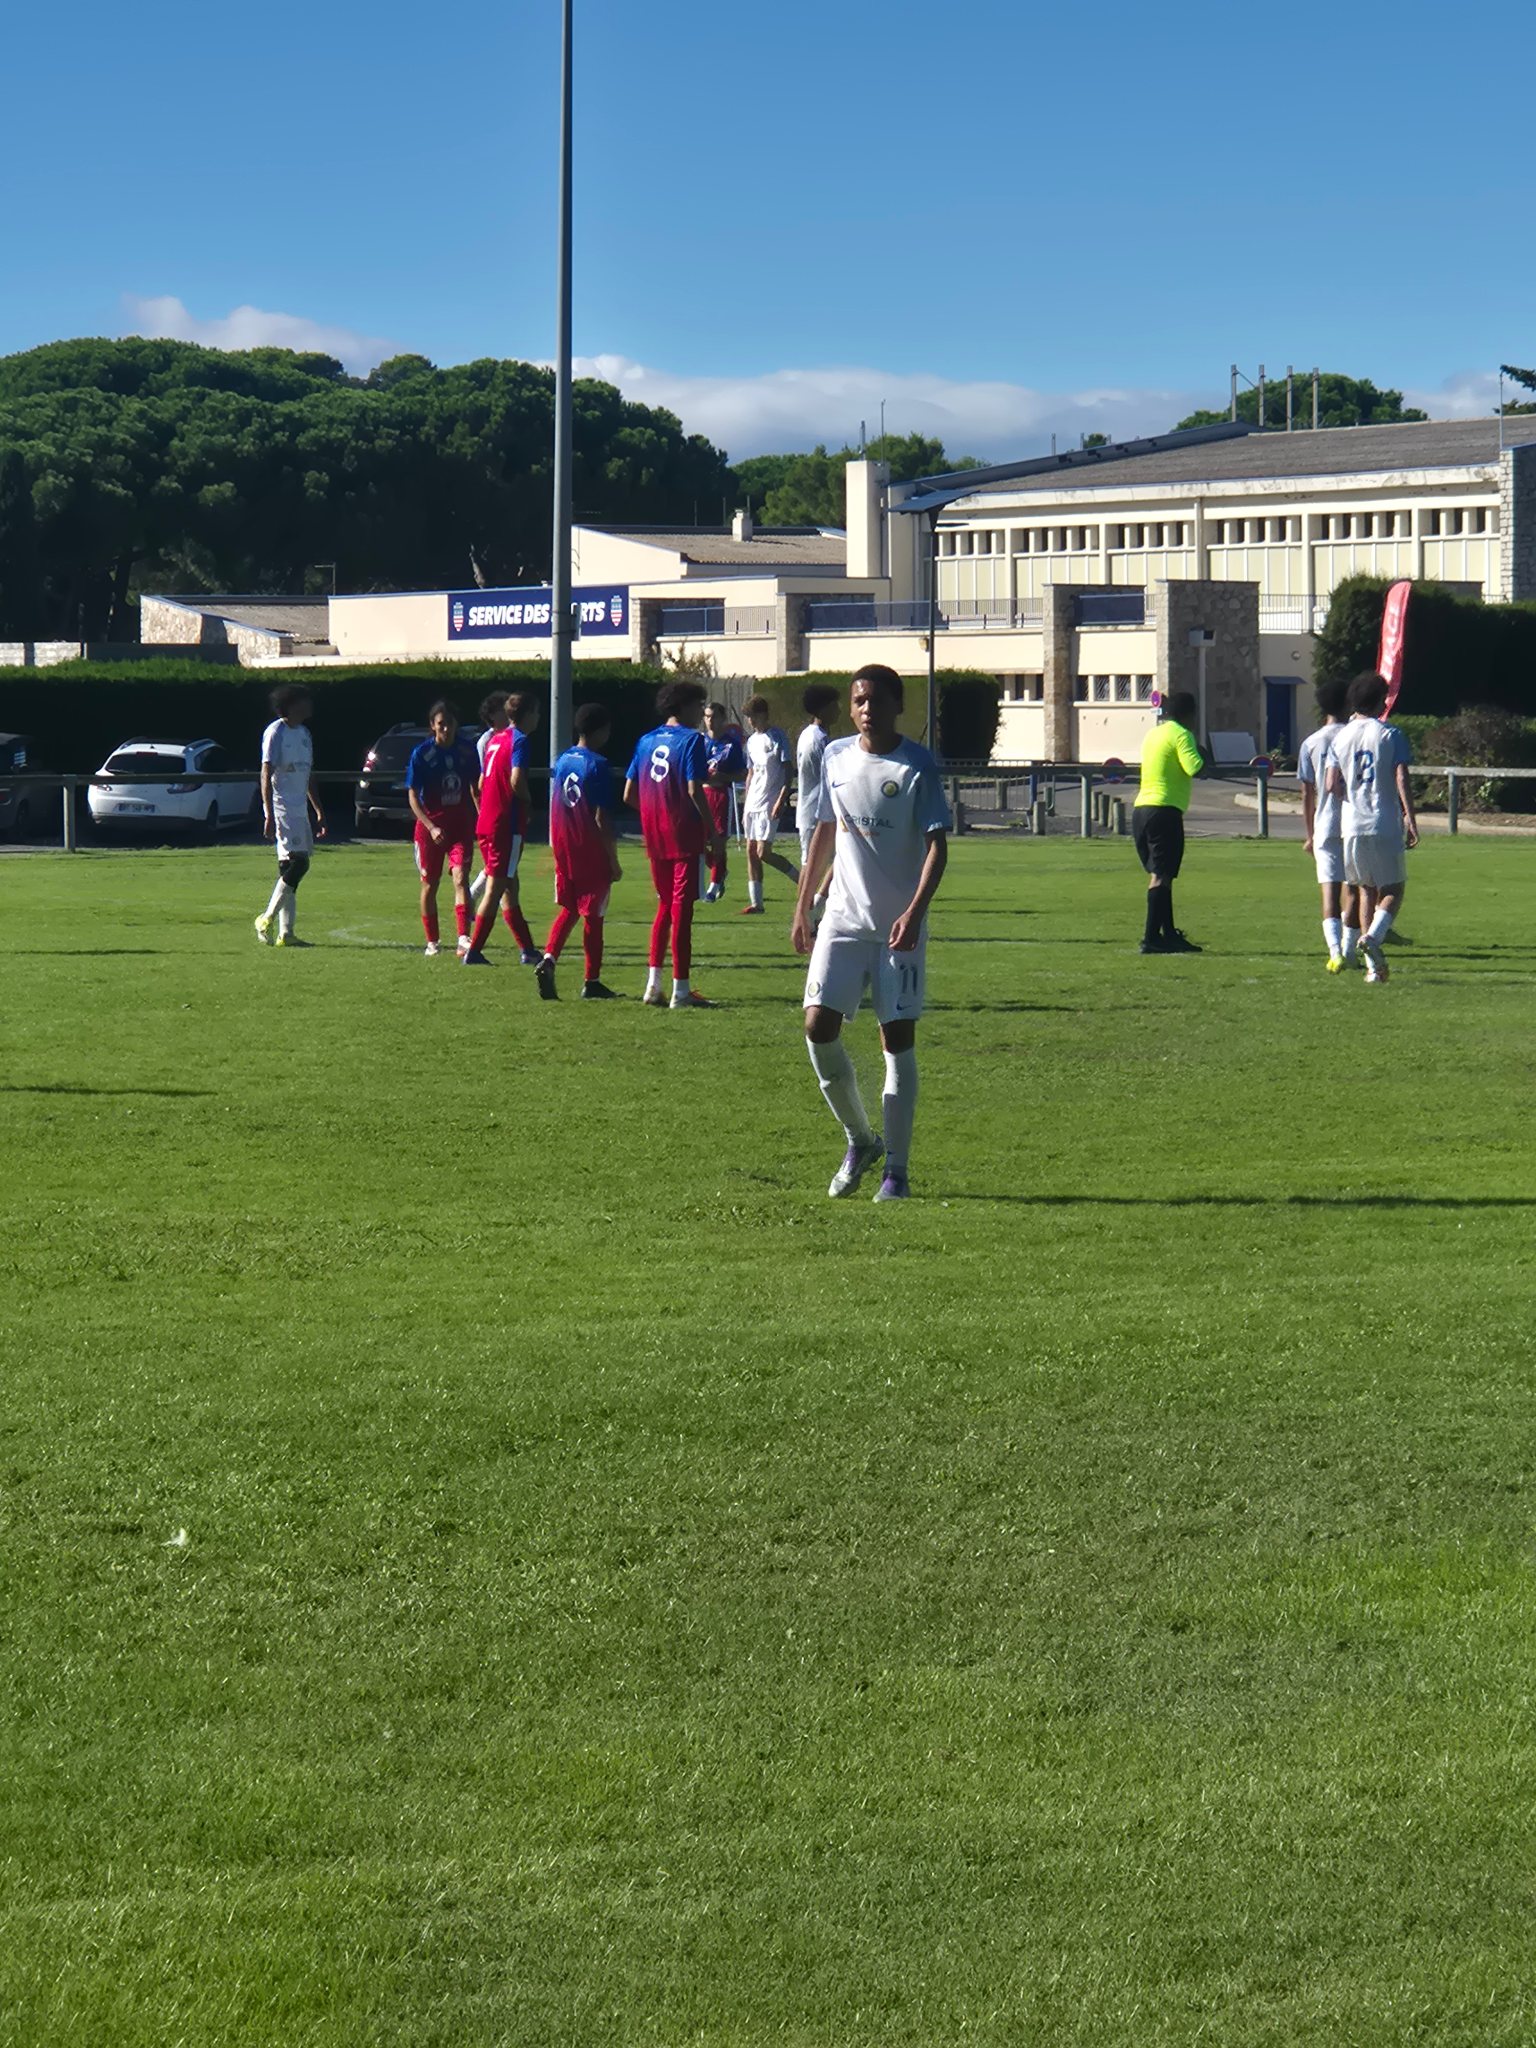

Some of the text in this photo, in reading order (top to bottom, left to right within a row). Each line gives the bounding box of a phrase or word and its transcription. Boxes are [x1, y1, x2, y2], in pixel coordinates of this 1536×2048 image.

[468, 604, 523, 626] SERVICE
[523, 602, 550, 625] DES
[485, 744, 500, 777] 7
[650, 745, 669, 783] 8
[563, 773, 582, 808] 6
[899, 961, 918, 996] 11
